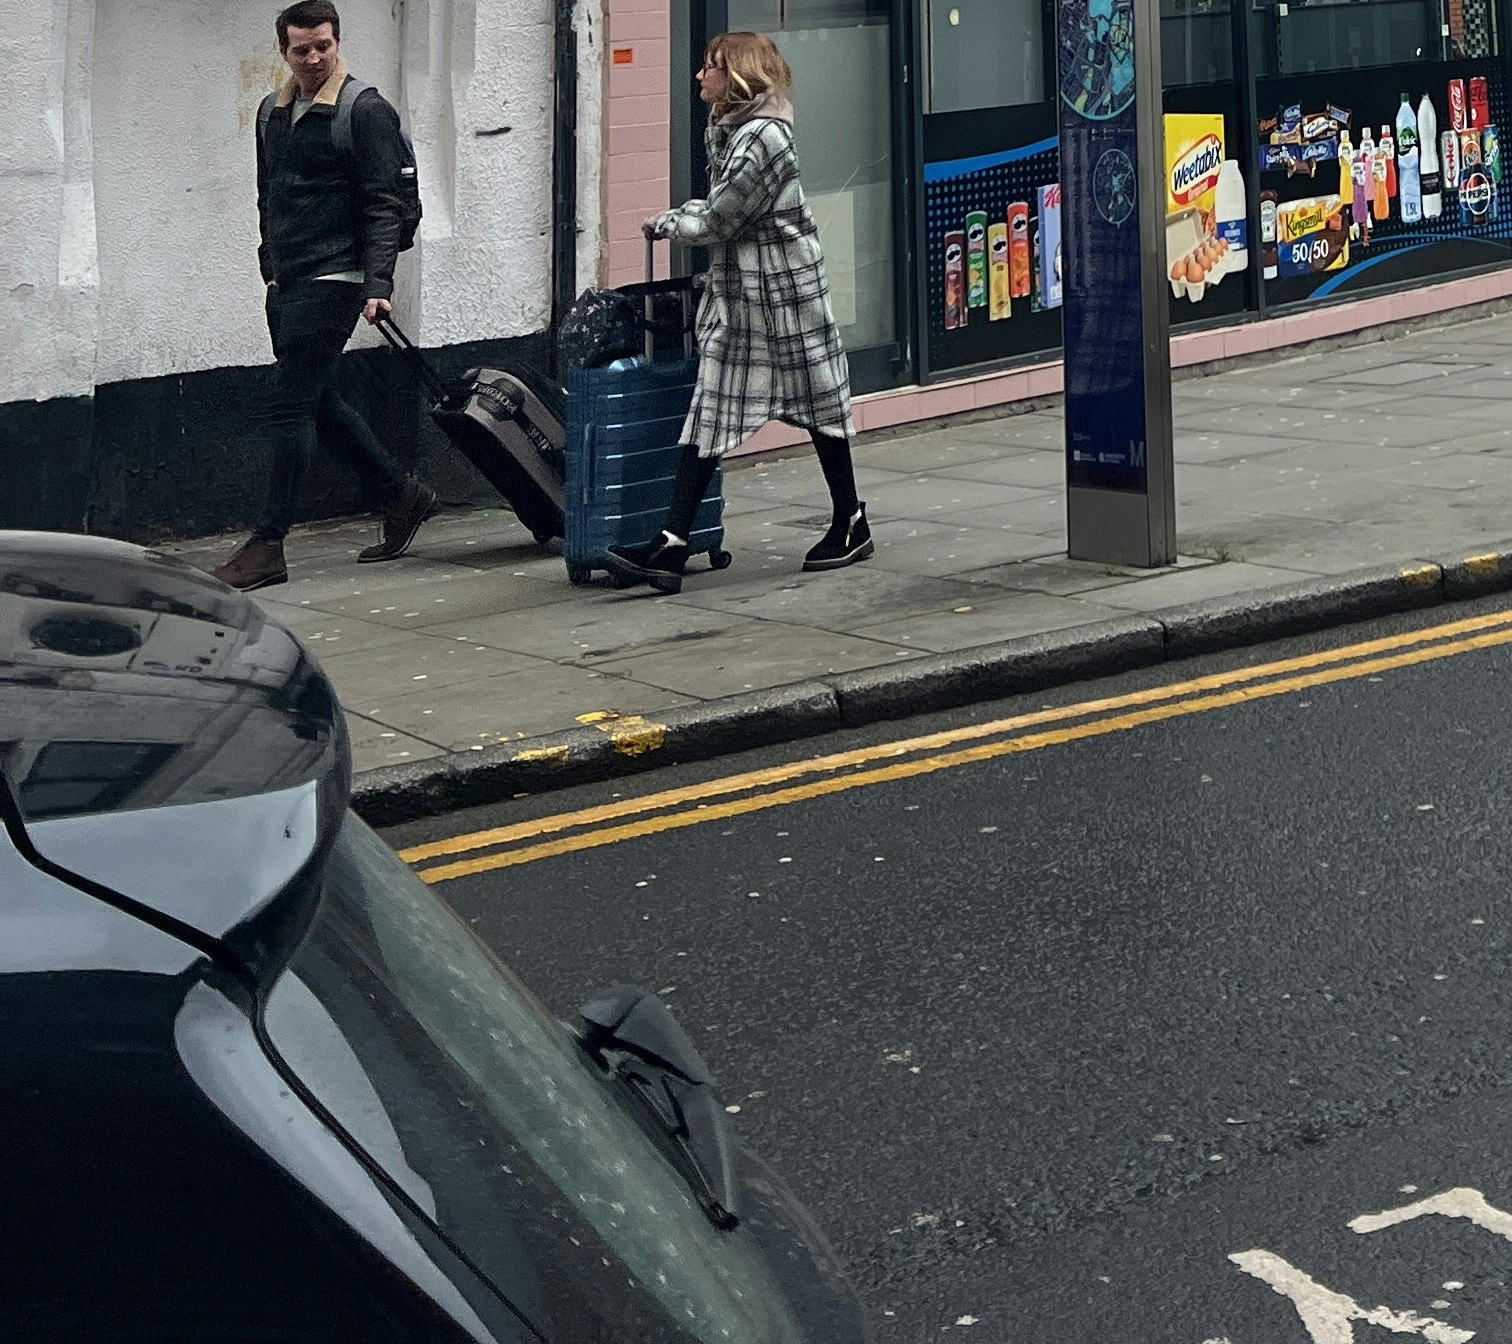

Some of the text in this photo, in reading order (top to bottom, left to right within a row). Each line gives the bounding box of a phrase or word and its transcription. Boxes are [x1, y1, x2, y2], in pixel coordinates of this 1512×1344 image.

[1174, 142, 1222, 191] Weetabix
[1468, 187, 1489, 199] PEPSI
[1286, 206, 1324, 240] Kingsmill
[1292, 239, 1329, 263] 50/50
